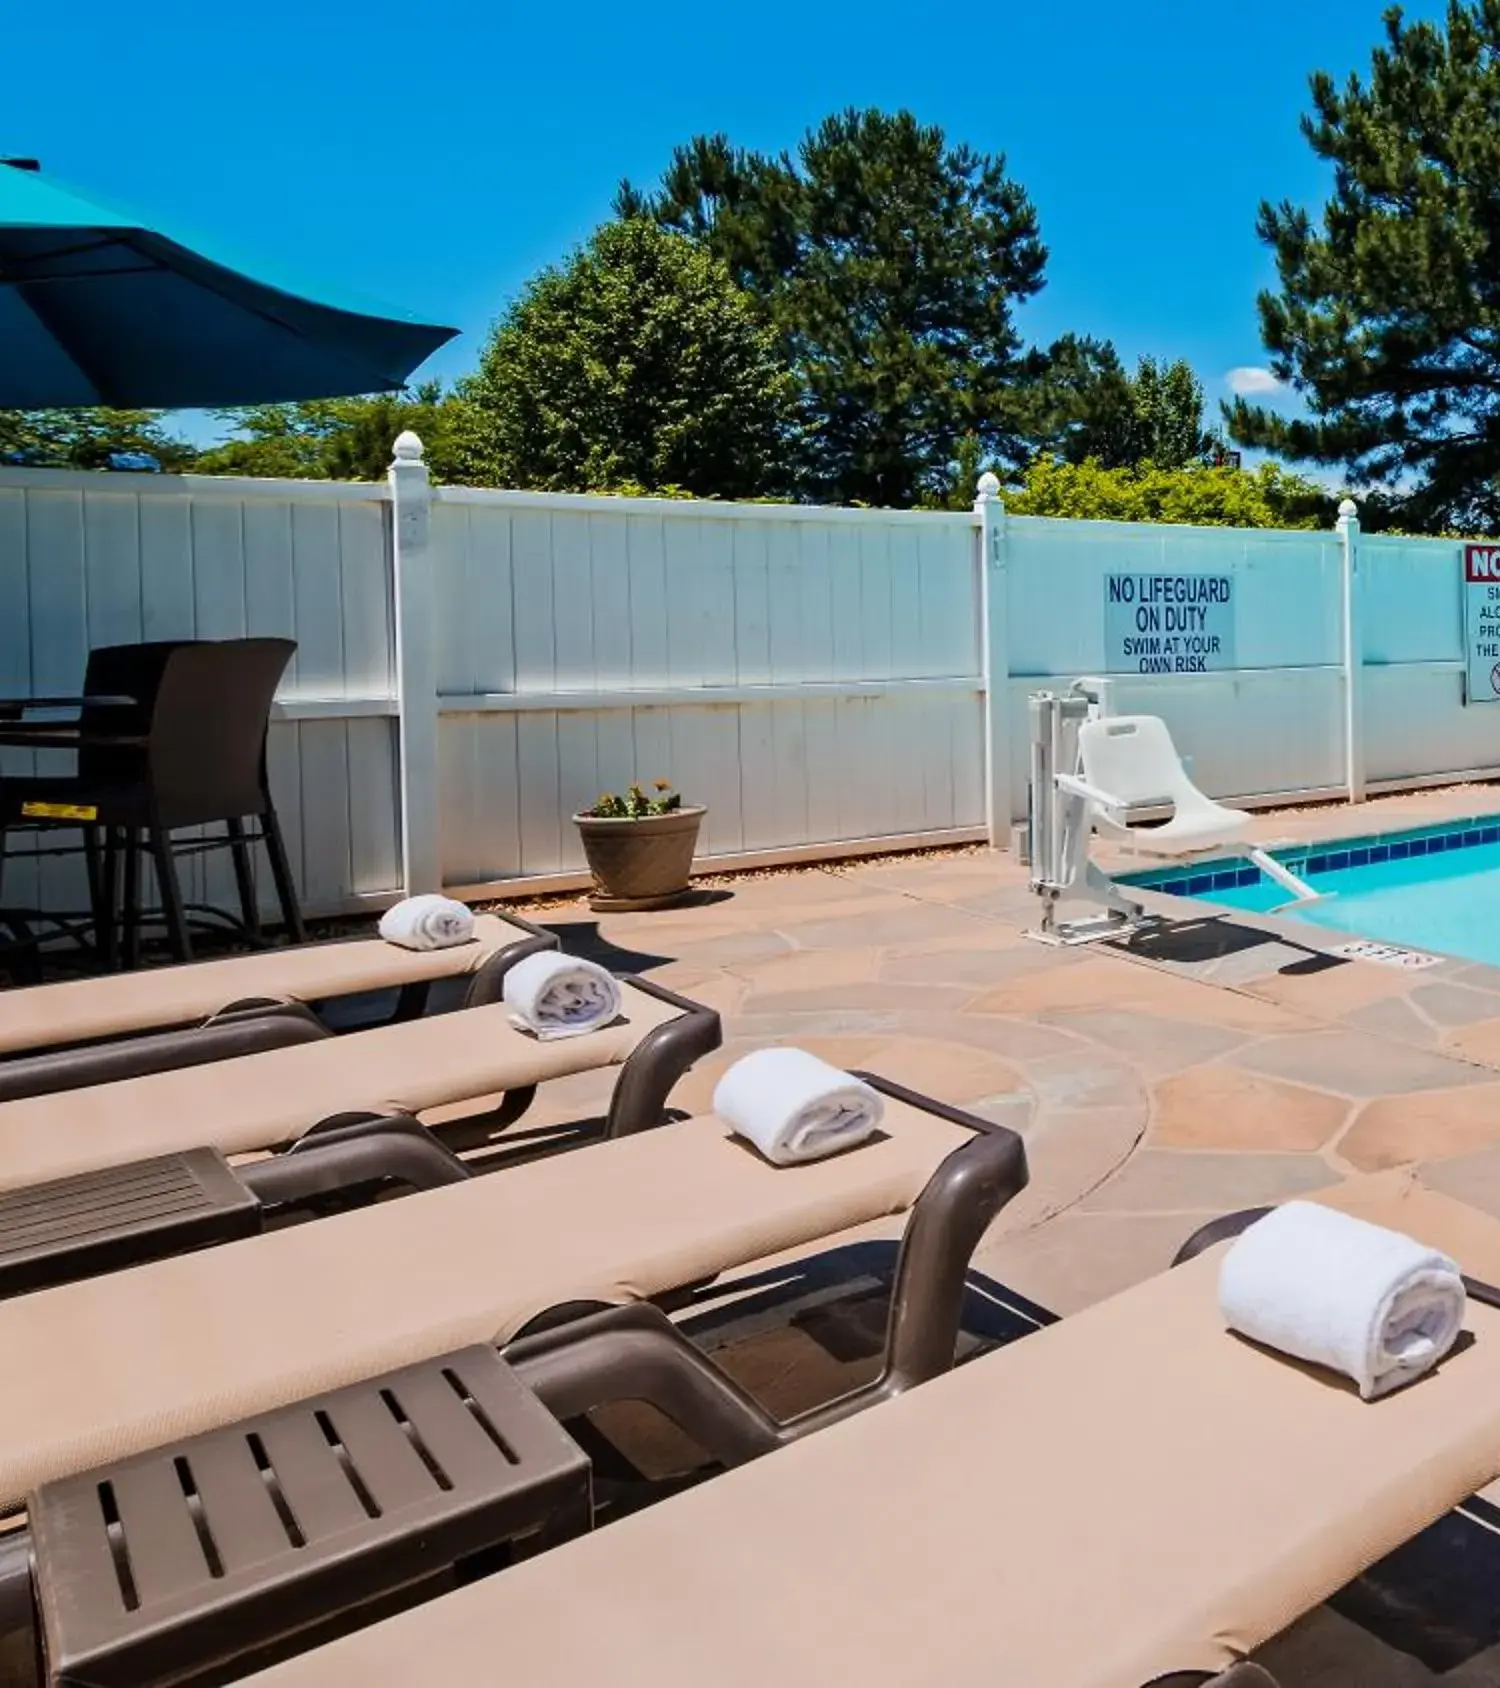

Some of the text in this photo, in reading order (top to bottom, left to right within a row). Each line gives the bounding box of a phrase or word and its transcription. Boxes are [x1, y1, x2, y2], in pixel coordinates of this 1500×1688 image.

[1109, 576, 1230, 603] NO LIFEGUARD
[1136, 606, 1207, 632] ON DUTY
[1123, 636, 1220, 655] SWIM AT YOUR
[1476, 644, 1498, 657] THE
[1140, 656, 1207, 674] OWN RISK
